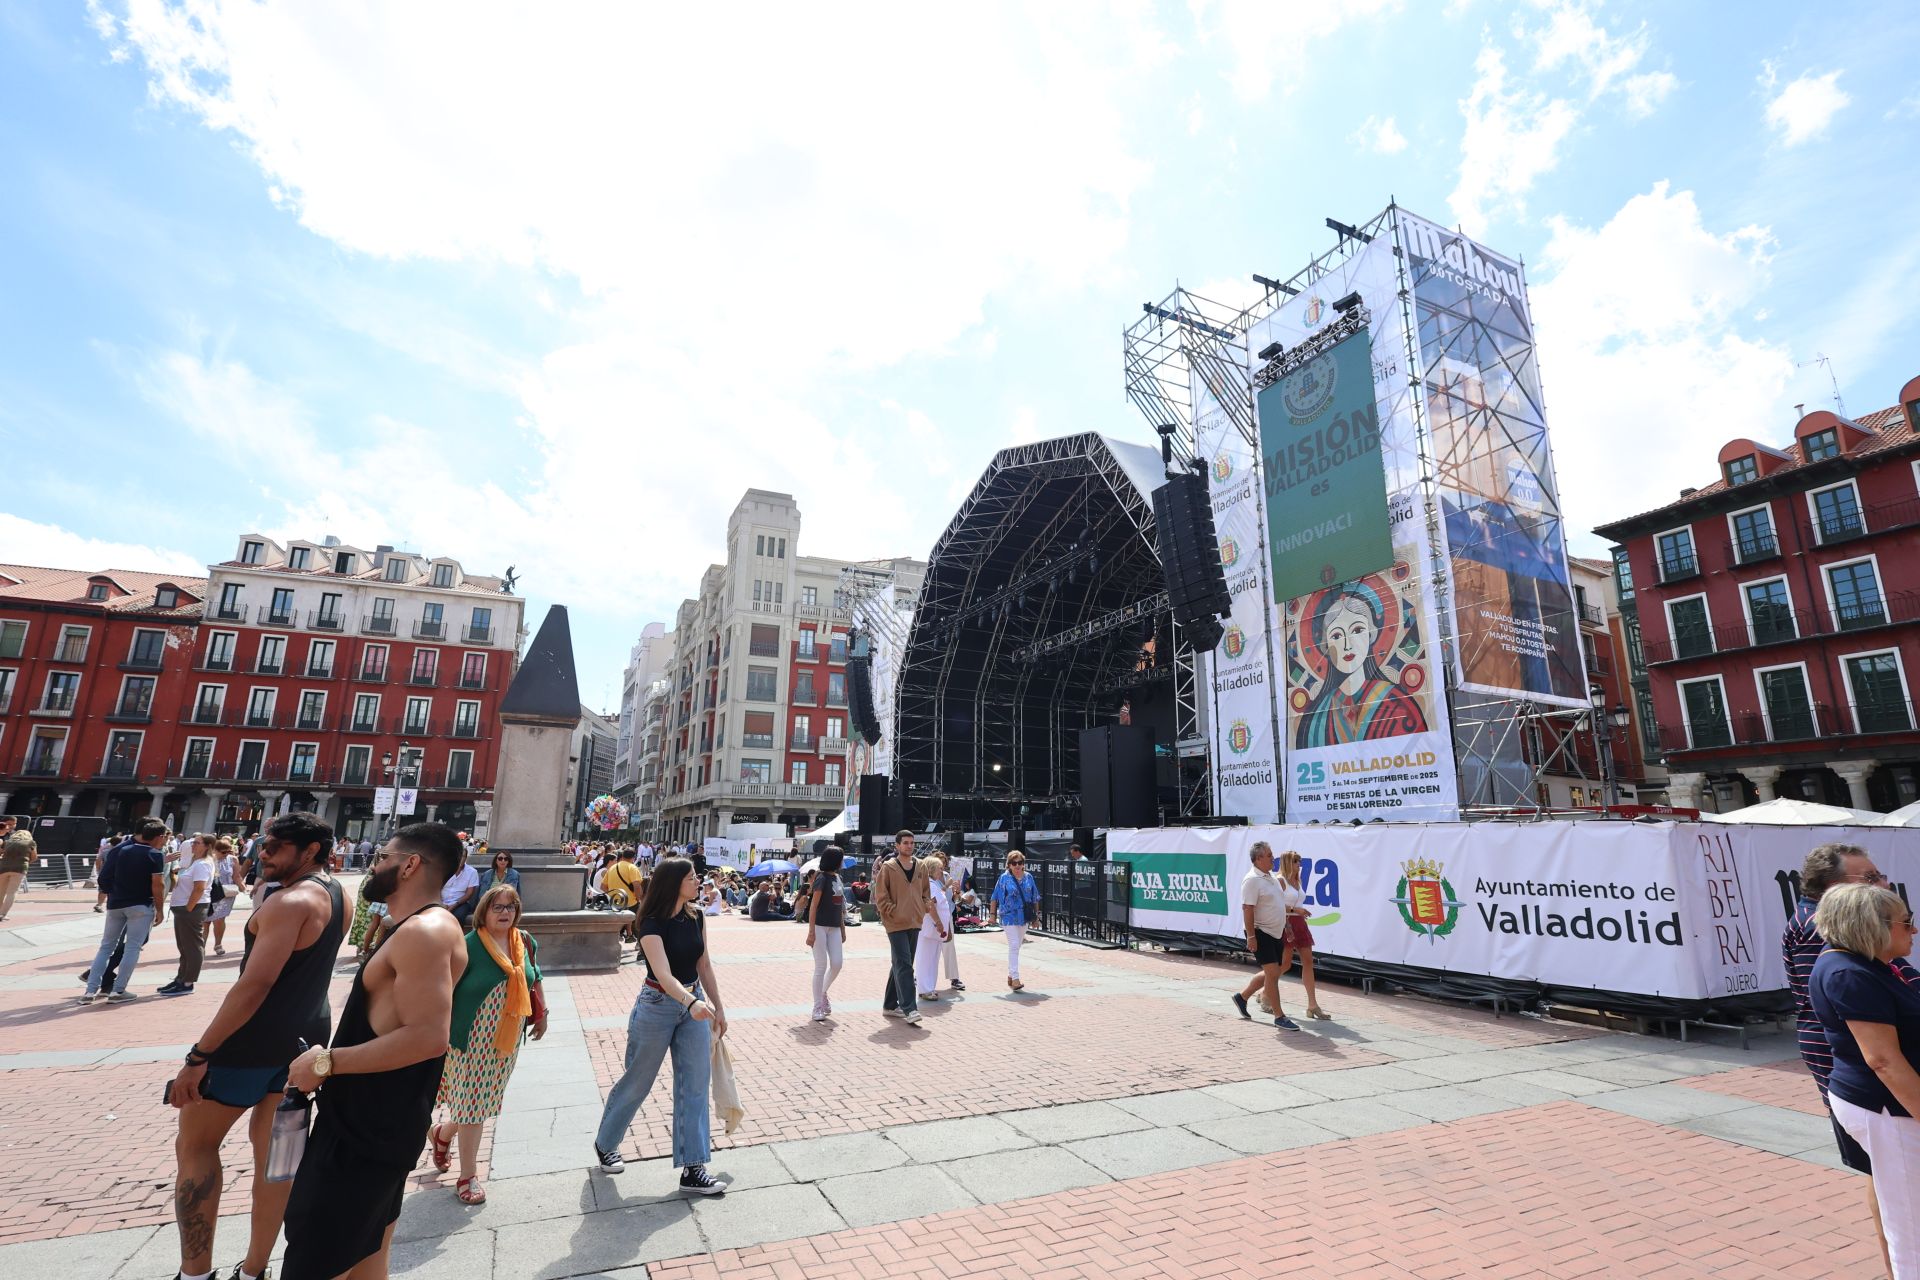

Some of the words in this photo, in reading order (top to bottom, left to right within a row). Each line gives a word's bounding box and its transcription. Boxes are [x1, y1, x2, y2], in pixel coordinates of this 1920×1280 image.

[1263, 403, 1378, 481] MISIÓN
[1265, 433, 1380, 499] VALLADOLID
[1311, 479, 1330, 497] es
[1213, 486, 1252, 514] lladolid
[1276, 512, 1353, 555] INNOVACI
[1230, 575, 1257, 595] dolid
[1480, 610, 1521, 625] VALLADOLID
[1489, 631, 1514, 643] MAHOU
[1526, 640, 1555, 652] TOSTADA
[1501, 643, 1510, 651] TE
[1220, 761, 1260, 773] yuntamiento
[1262, 759, 1271, 767] de
[1297, 761, 1325, 785] 25
[1332, 752, 1436, 775] VALLADOLID
[1358, 774, 1409, 784] SEPTIEMBRE
[1419, 771, 1439, 779] 2025
[1298, 794, 1321, 803] FERIA
[1324, 793, 1330, 801] Y
[1333, 790, 1366, 800] FIESTAS
[1369, 789, 1381, 797] DE
[1385, 788, 1398, 796] LA
[1402, 784, 1441, 795] VIRGEN
[1327, 803, 1338, 811] DE
[1340, 801, 1357, 810] SAN
[1358, 798, 1403, 809] LORENZO
[977, 861, 993, 869] BLAPE
[1024, 864, 1042, 872] LAPE
[1048, 864, 1068, 875] BLAPE
[1075, 865, 1096, 876] BLAPE
[1103, 865, 1125, 876] BLAPE
[1131, 872, 1167, 890] CAJA
[1168, 873, 1223, 892] RURAL
[1475, 877, 1635, 900] Ayuntamiento
[1644, 882, 1675, 902] de
[1143, 889, 1158, 900] DE
[1161, 890, 1210, 903] ZAMORA
[1477, 902, 1684, 946] Valladolid
[1724, 973, 1758, 993] DUERO
